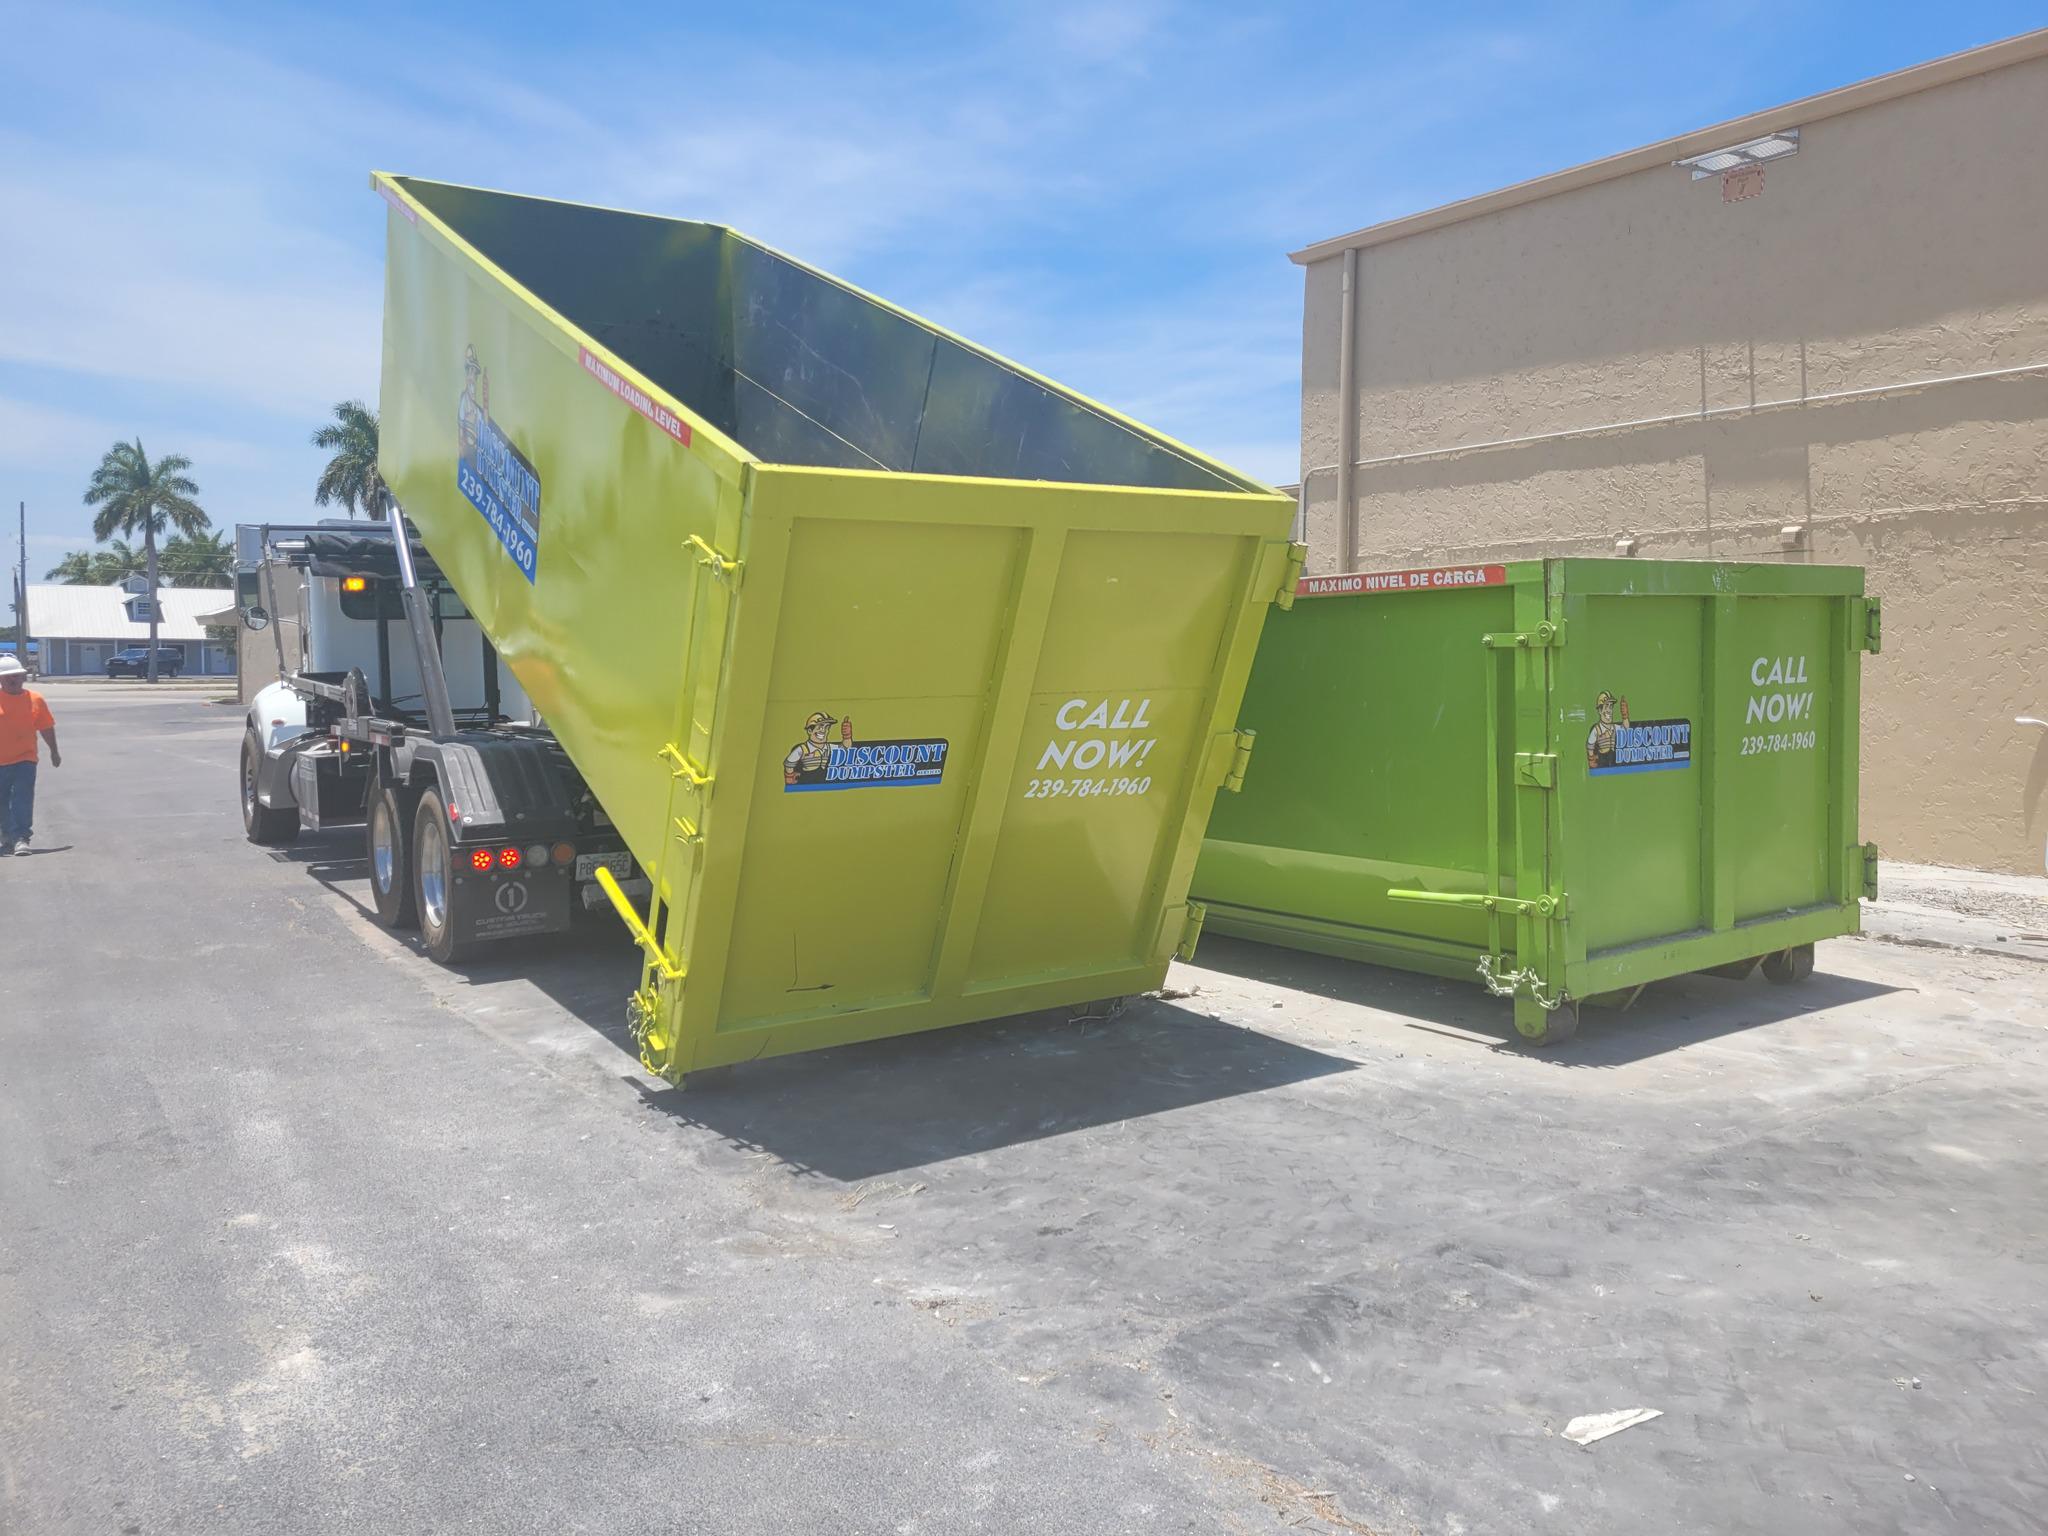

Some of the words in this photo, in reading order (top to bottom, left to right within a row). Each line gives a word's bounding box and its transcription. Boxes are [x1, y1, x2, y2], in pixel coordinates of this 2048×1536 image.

[584, 353, 620, 392] MAXIMUM
[655, 407, 682, 438] LEVEL
[460, 468, 532, 571] 239-784-1960
[1309, 578, 1362, 593] MAXIMO
[1366, 575, 1406, 589] NIVEL
[1410, 573, 1429, 587] DE
[1750, 655, 1808, 687] CALL
[1055, 698, 1151, 731] CALL
[1745, 691, 1814, 725] NOW!
[1616, 723, 1690, 748] DISCOUNT
[1740, 730, 1816, 755] 239-784-1960
[829, 744, 946, 767] DISCOUNT
[1036, 739, 1157, 770] NOW!
[1616, 745, 1673, 764] DUMPSTER
[826, 764, 915, 781] DUMPSTER
[1023, 776, 1152, 798] 239-784-1960
